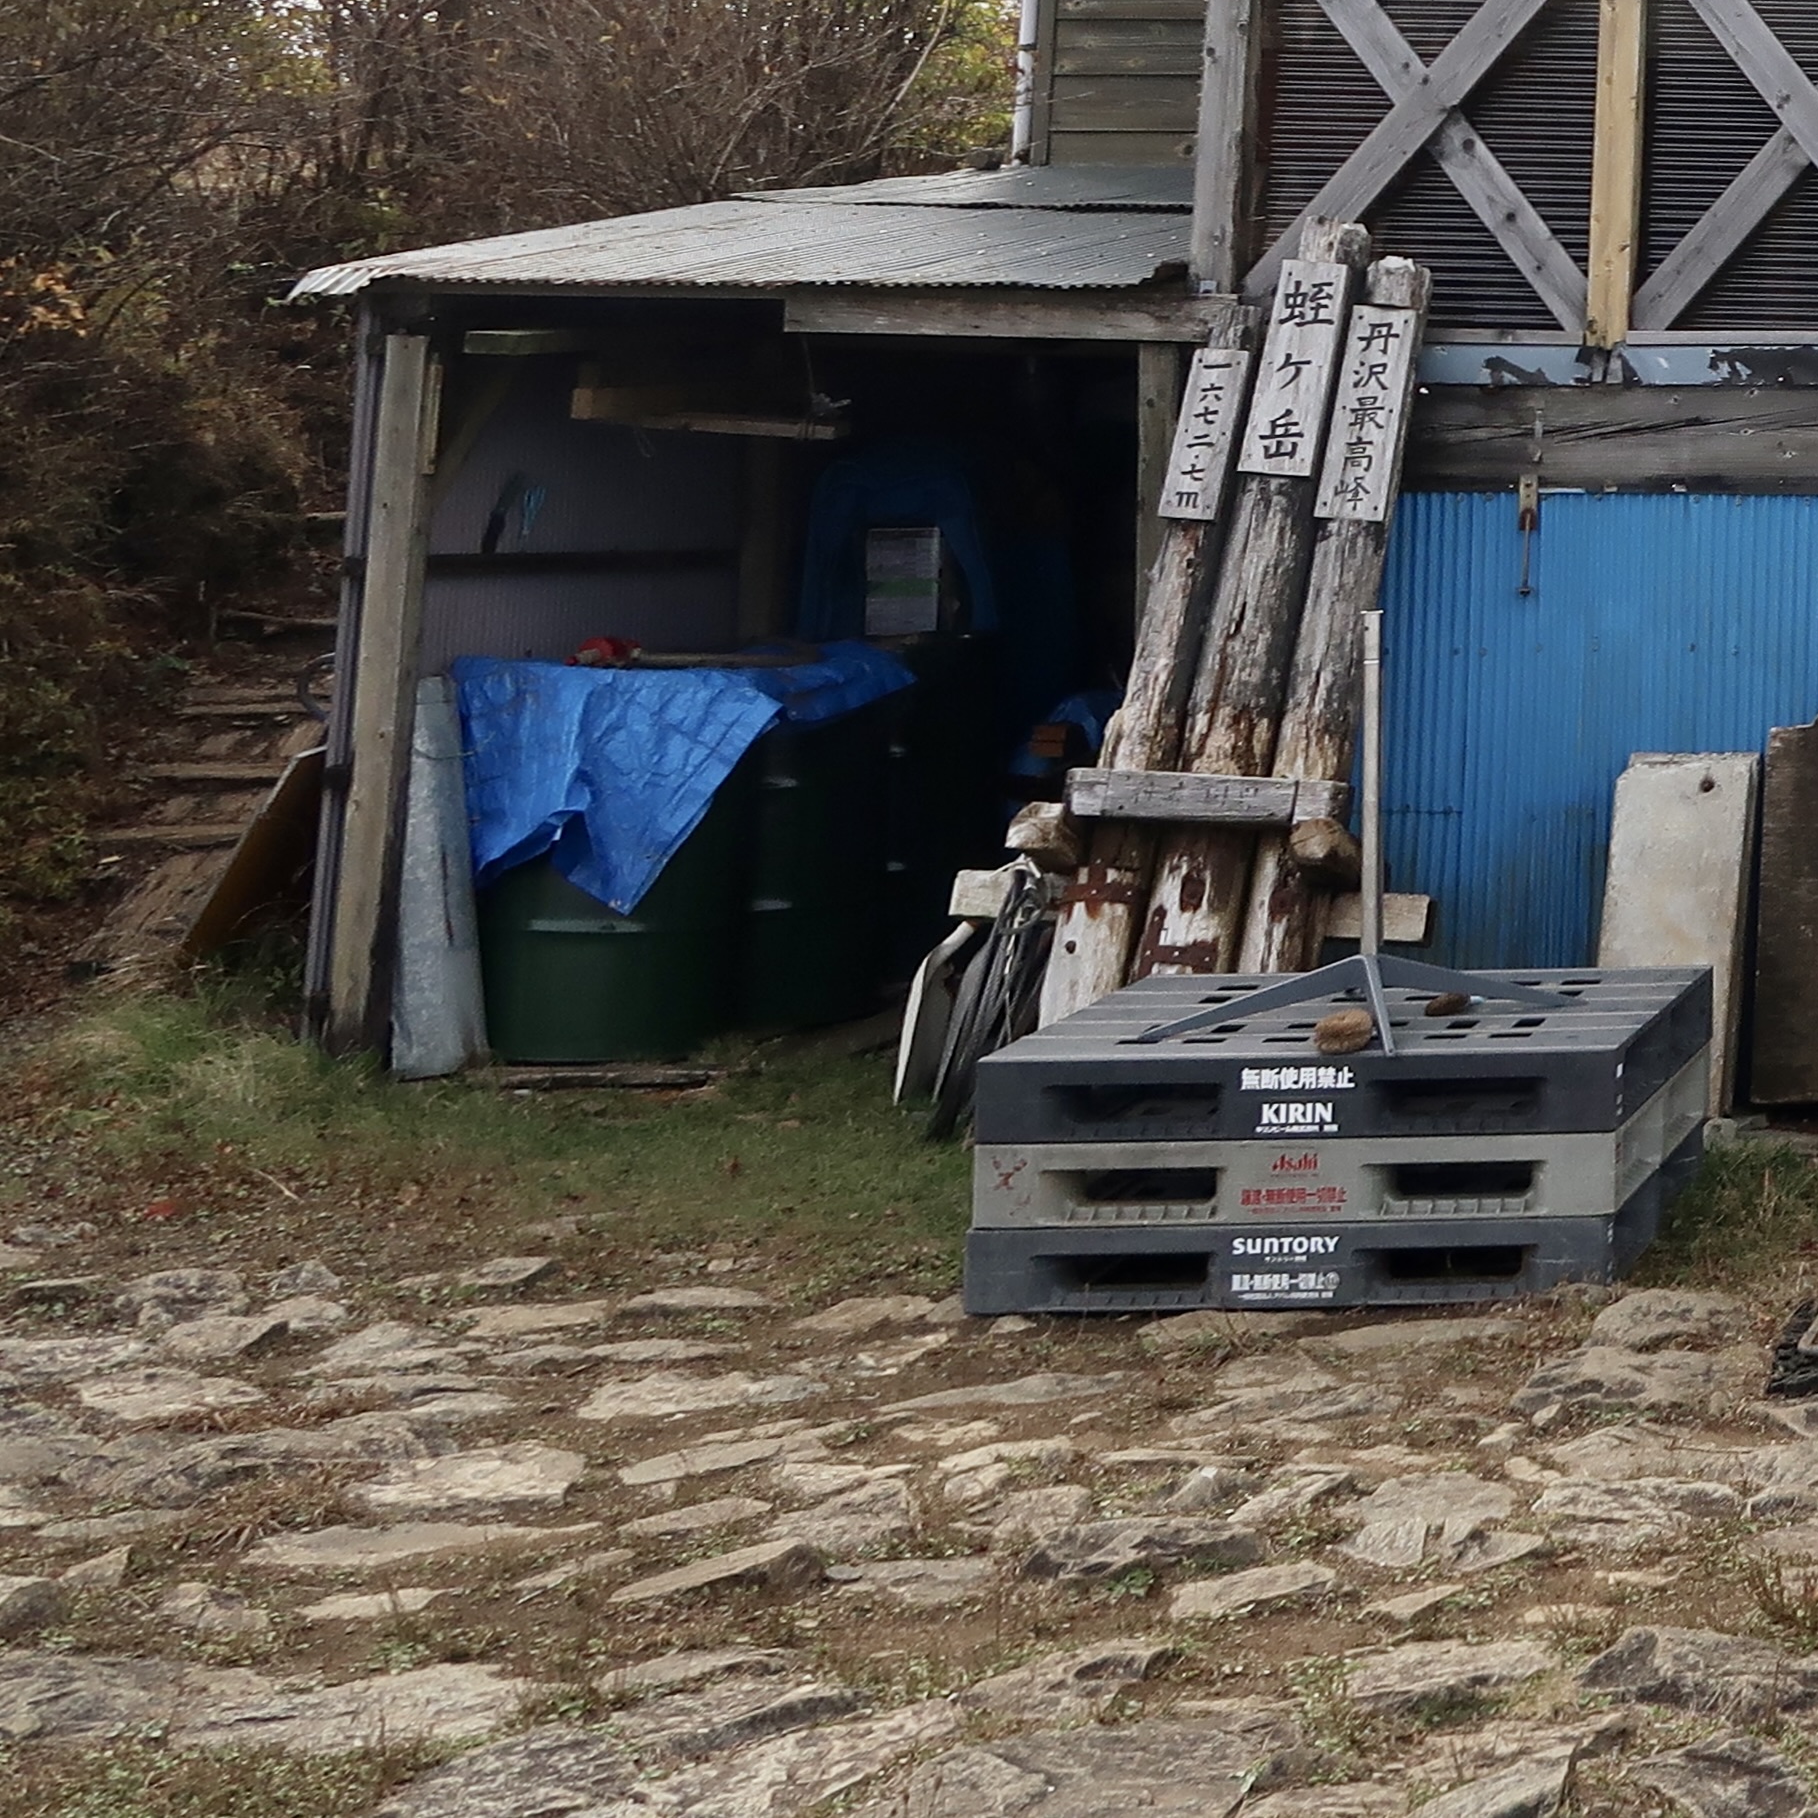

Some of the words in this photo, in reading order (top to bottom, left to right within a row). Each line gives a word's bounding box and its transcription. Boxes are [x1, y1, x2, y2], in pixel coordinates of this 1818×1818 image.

[1334, 321, 1400, 512] 丹沢最高峰
[1240, 1066, 1355, 1092] 無断使用禁止
[1261, 1102, 1333, 1124] KIRIN
[1272, 1152, 1318, 1172] Asahi
[1231, 1236, 1340, 1256] SUNTORY
